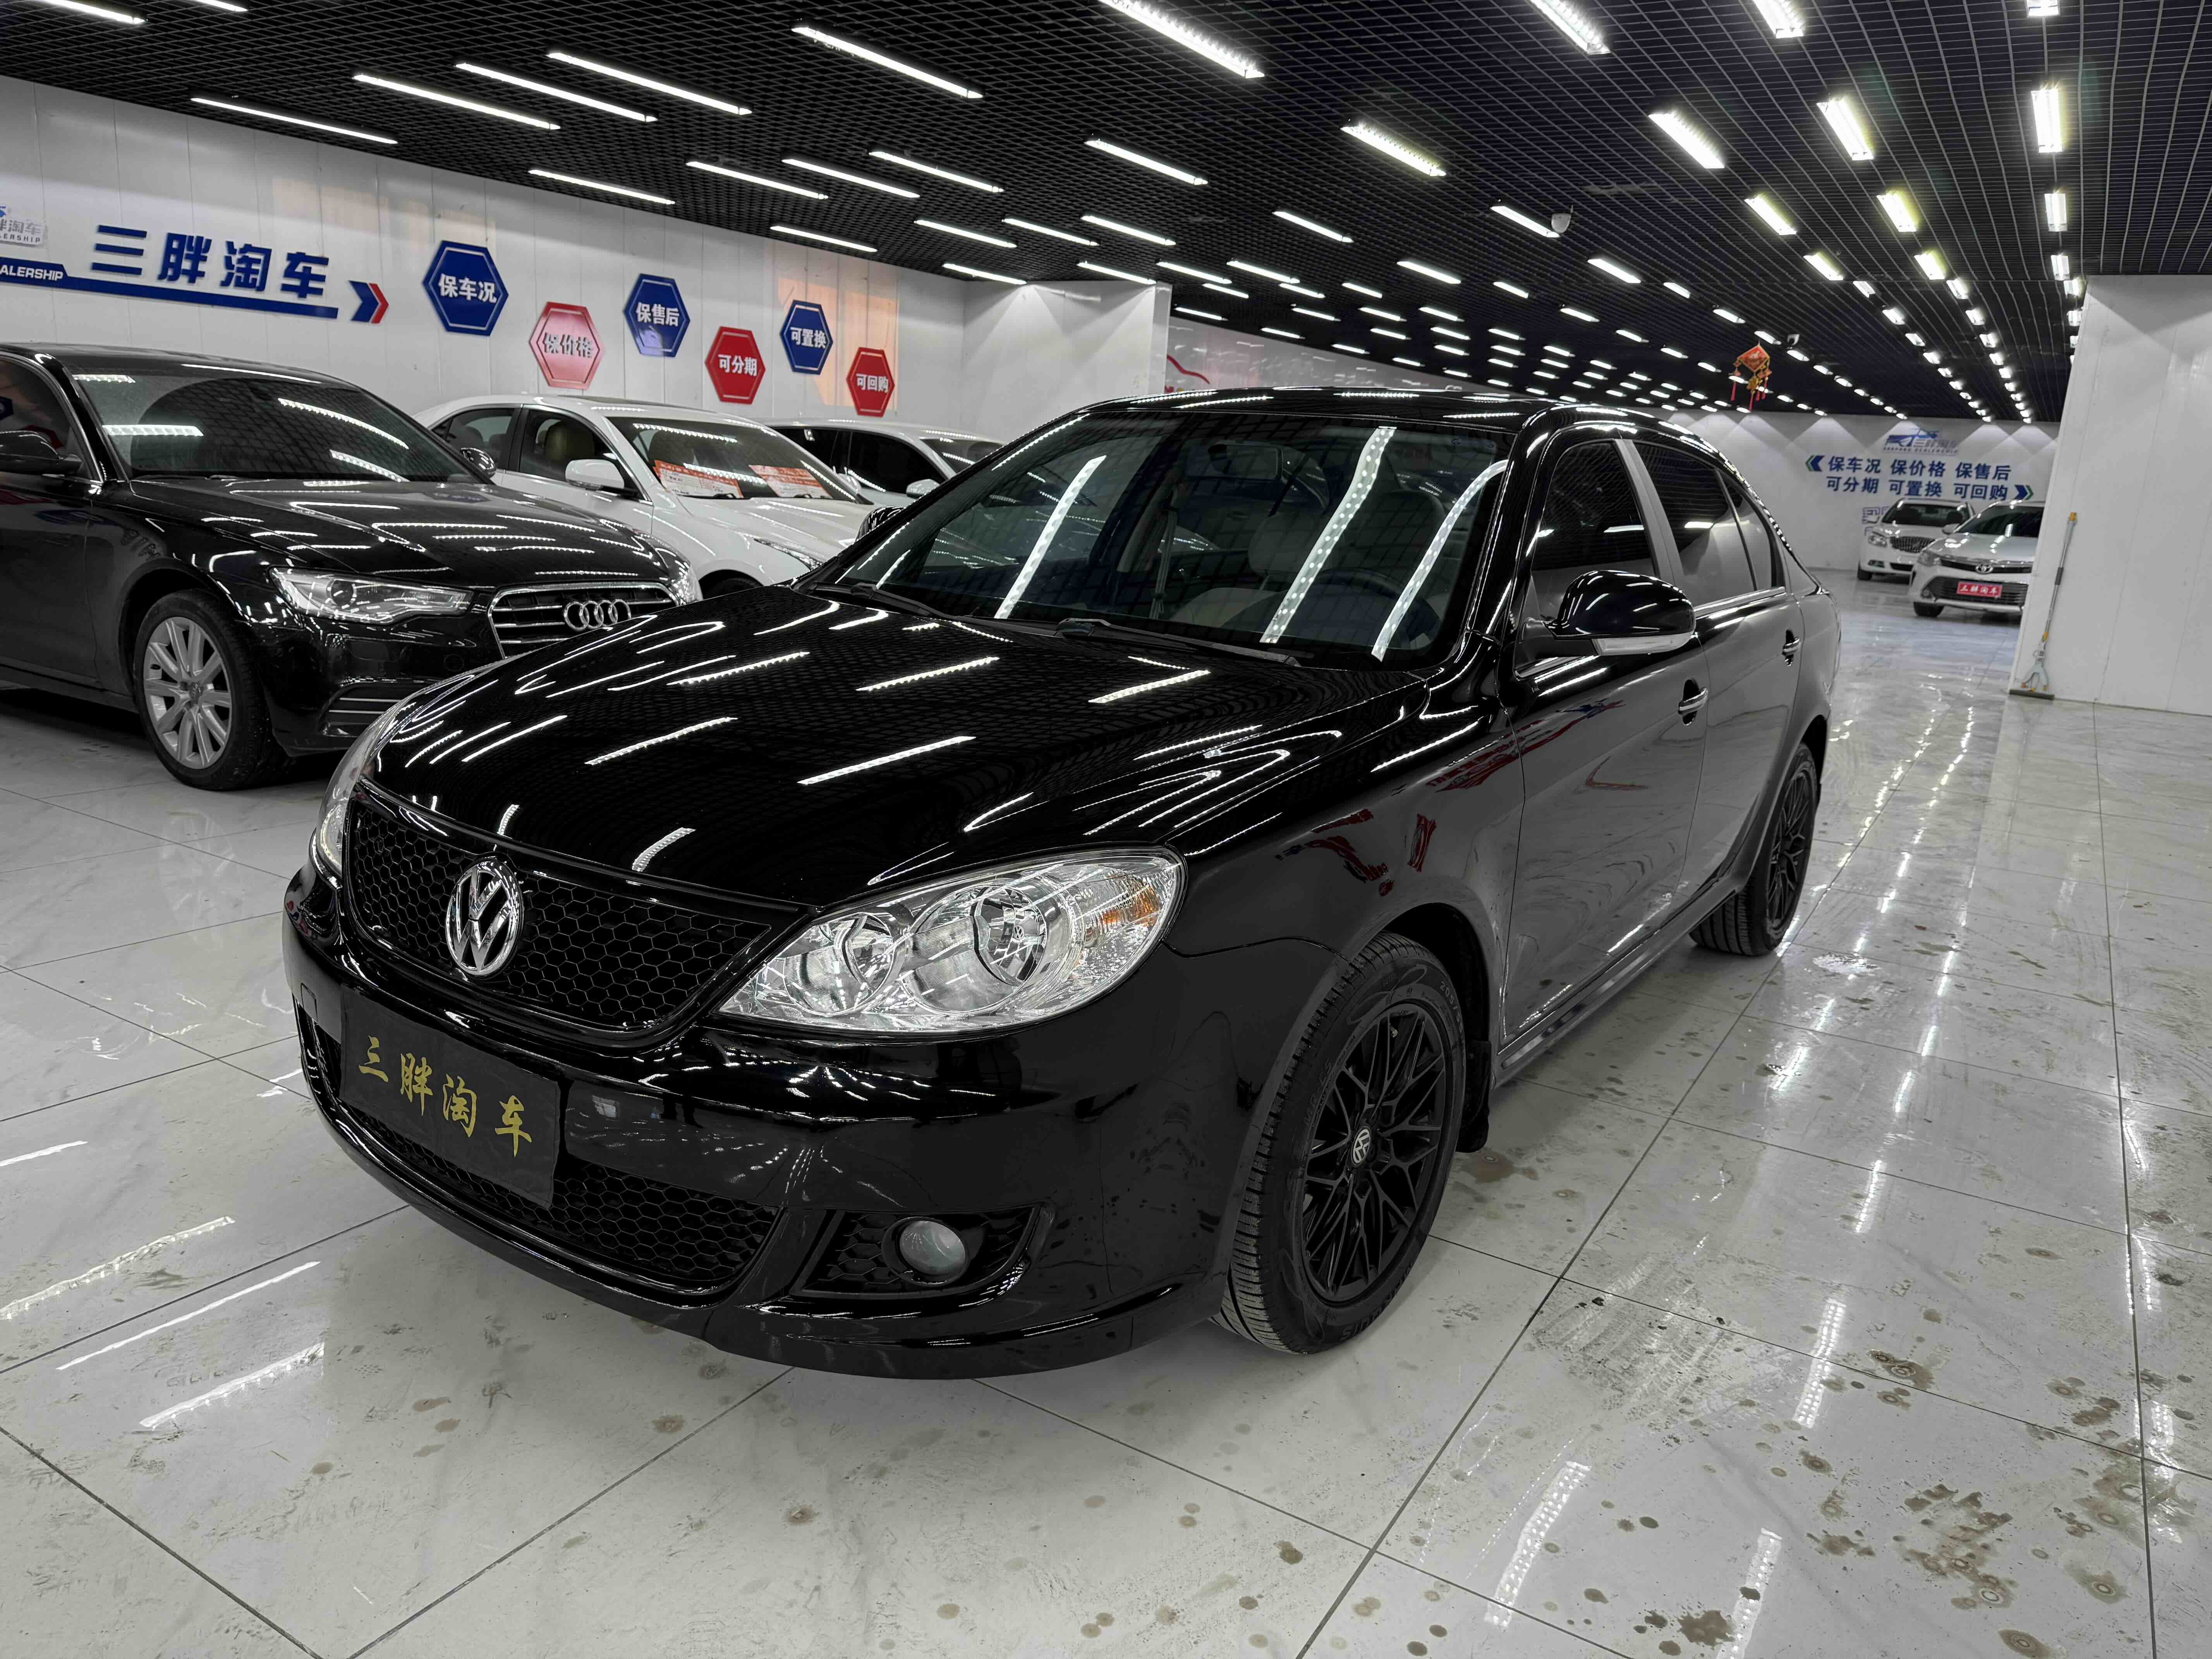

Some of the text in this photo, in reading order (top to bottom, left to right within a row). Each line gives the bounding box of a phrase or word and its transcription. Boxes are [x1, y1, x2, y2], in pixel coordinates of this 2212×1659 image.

[0, 264, 64, 281] ALERSHIP
[91, 224, 329, 299] 三胖淘车
[438, 273, 497, 304] 保车况
[636, 302, 680, 328] 保售后
[543, 332, 593, 359] 保价格
[789, 326, 827, 349] 可置换
[718, 354, 758, 377] 可分期
[856, 374, 889, 393] 可回购
[1828, 456, 2011, 481] 保车况 保价格 保售后
[1826, 476, 2008, 501] 可分期 可置换 可回购
[358, 1035, 533, 1158] 三胖淘车
